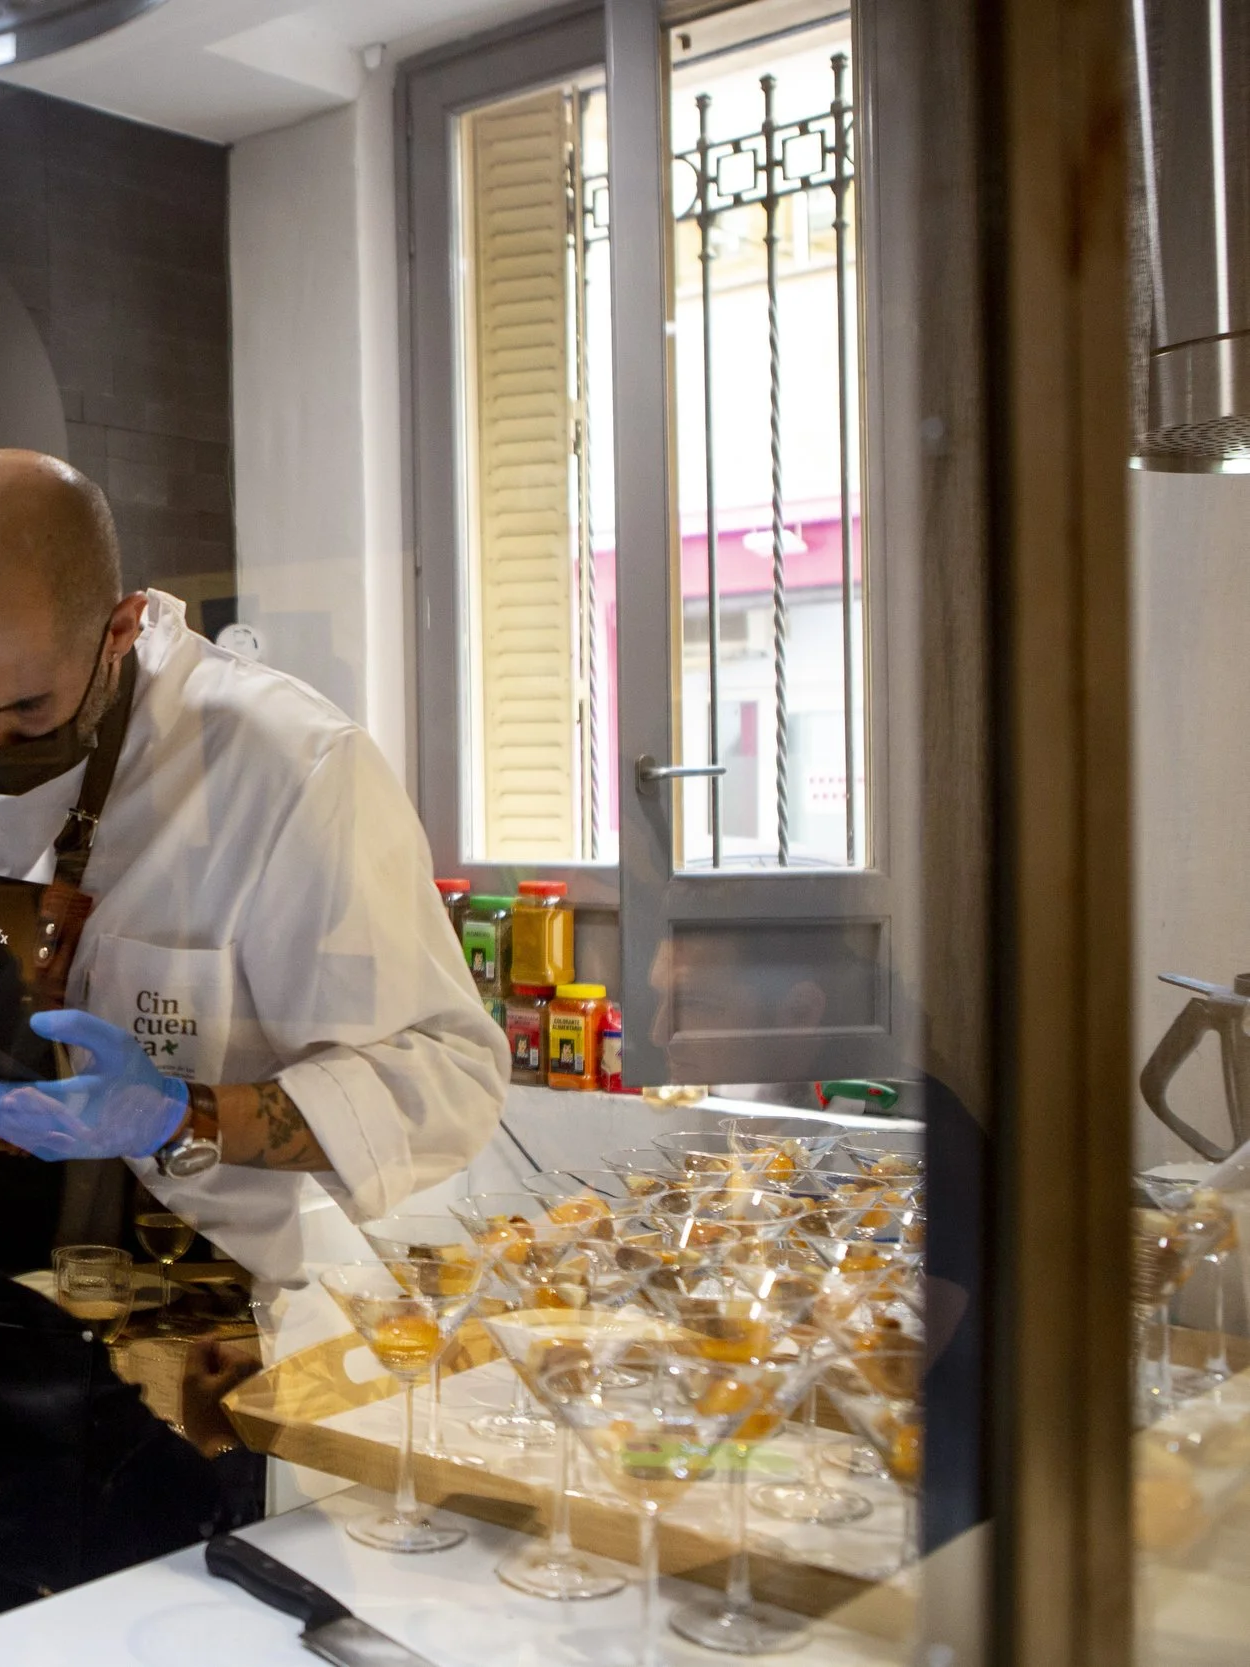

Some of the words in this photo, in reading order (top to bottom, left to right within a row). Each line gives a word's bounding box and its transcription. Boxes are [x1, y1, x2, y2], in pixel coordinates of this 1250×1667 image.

[136, 990, 179, 1015] Cin
[133, 1017, 198, 1036] cuen
[134, 1036, 157, 1057] a
